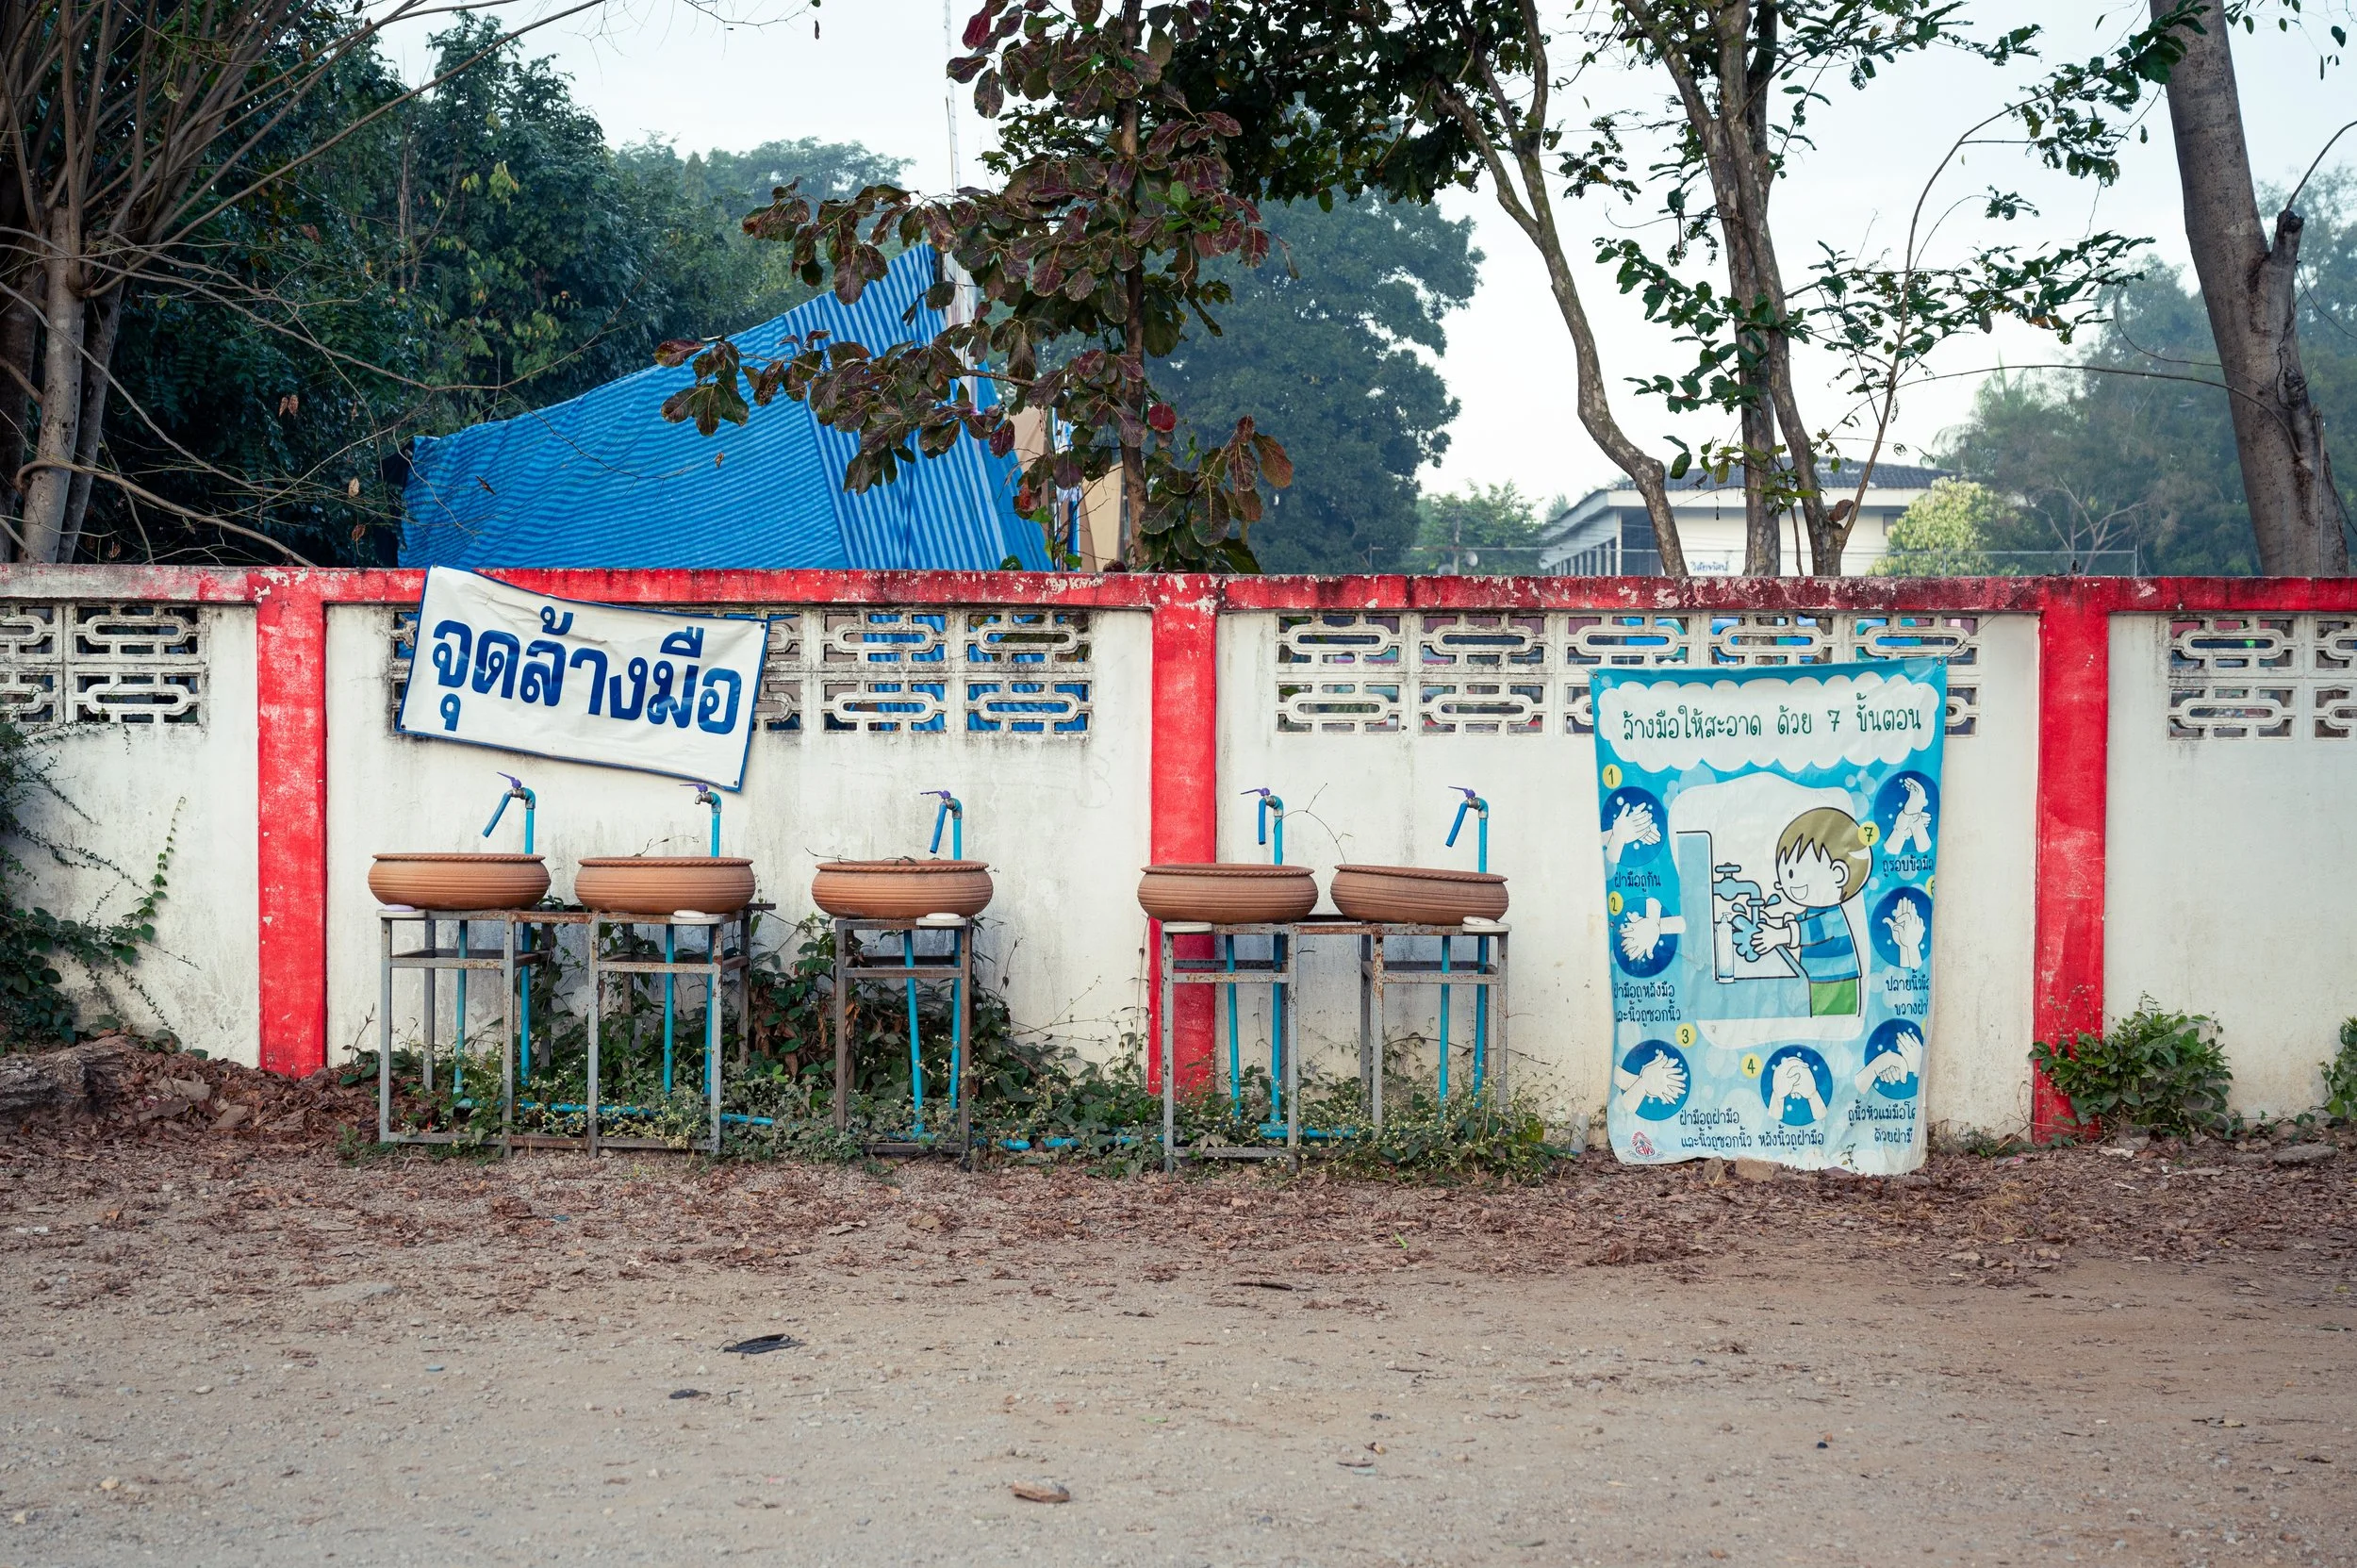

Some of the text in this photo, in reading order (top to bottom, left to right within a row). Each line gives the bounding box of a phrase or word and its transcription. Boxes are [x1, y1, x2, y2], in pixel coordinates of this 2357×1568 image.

[432, 605, 743, 734] จุดล้างมือ
[1623, 693, 1921, 740] ล้างมือให้สะอาด ด้วย 7 ขั้นตอน
[1607, 767, 1614, 785] 1
[1864, 826, 1874, 843] 7
[1614, 871, 1662, 892] ฝ่ามือถูกัน
[1610, 897, 1618, 913] 2
[1681, 1028, 1689, 1045] 3
[1747, 1058, 1756, 1075] 4
[1679, 1108, 1740, 1131] ฝ่ามือถูฝ่ามือ
[1681, 1125, 1753, 1151] และนิ้วถูซอกนิ้ว
[1758, 1125, 1824, 1151] หลังนิ้วถูฝ่ามือ
